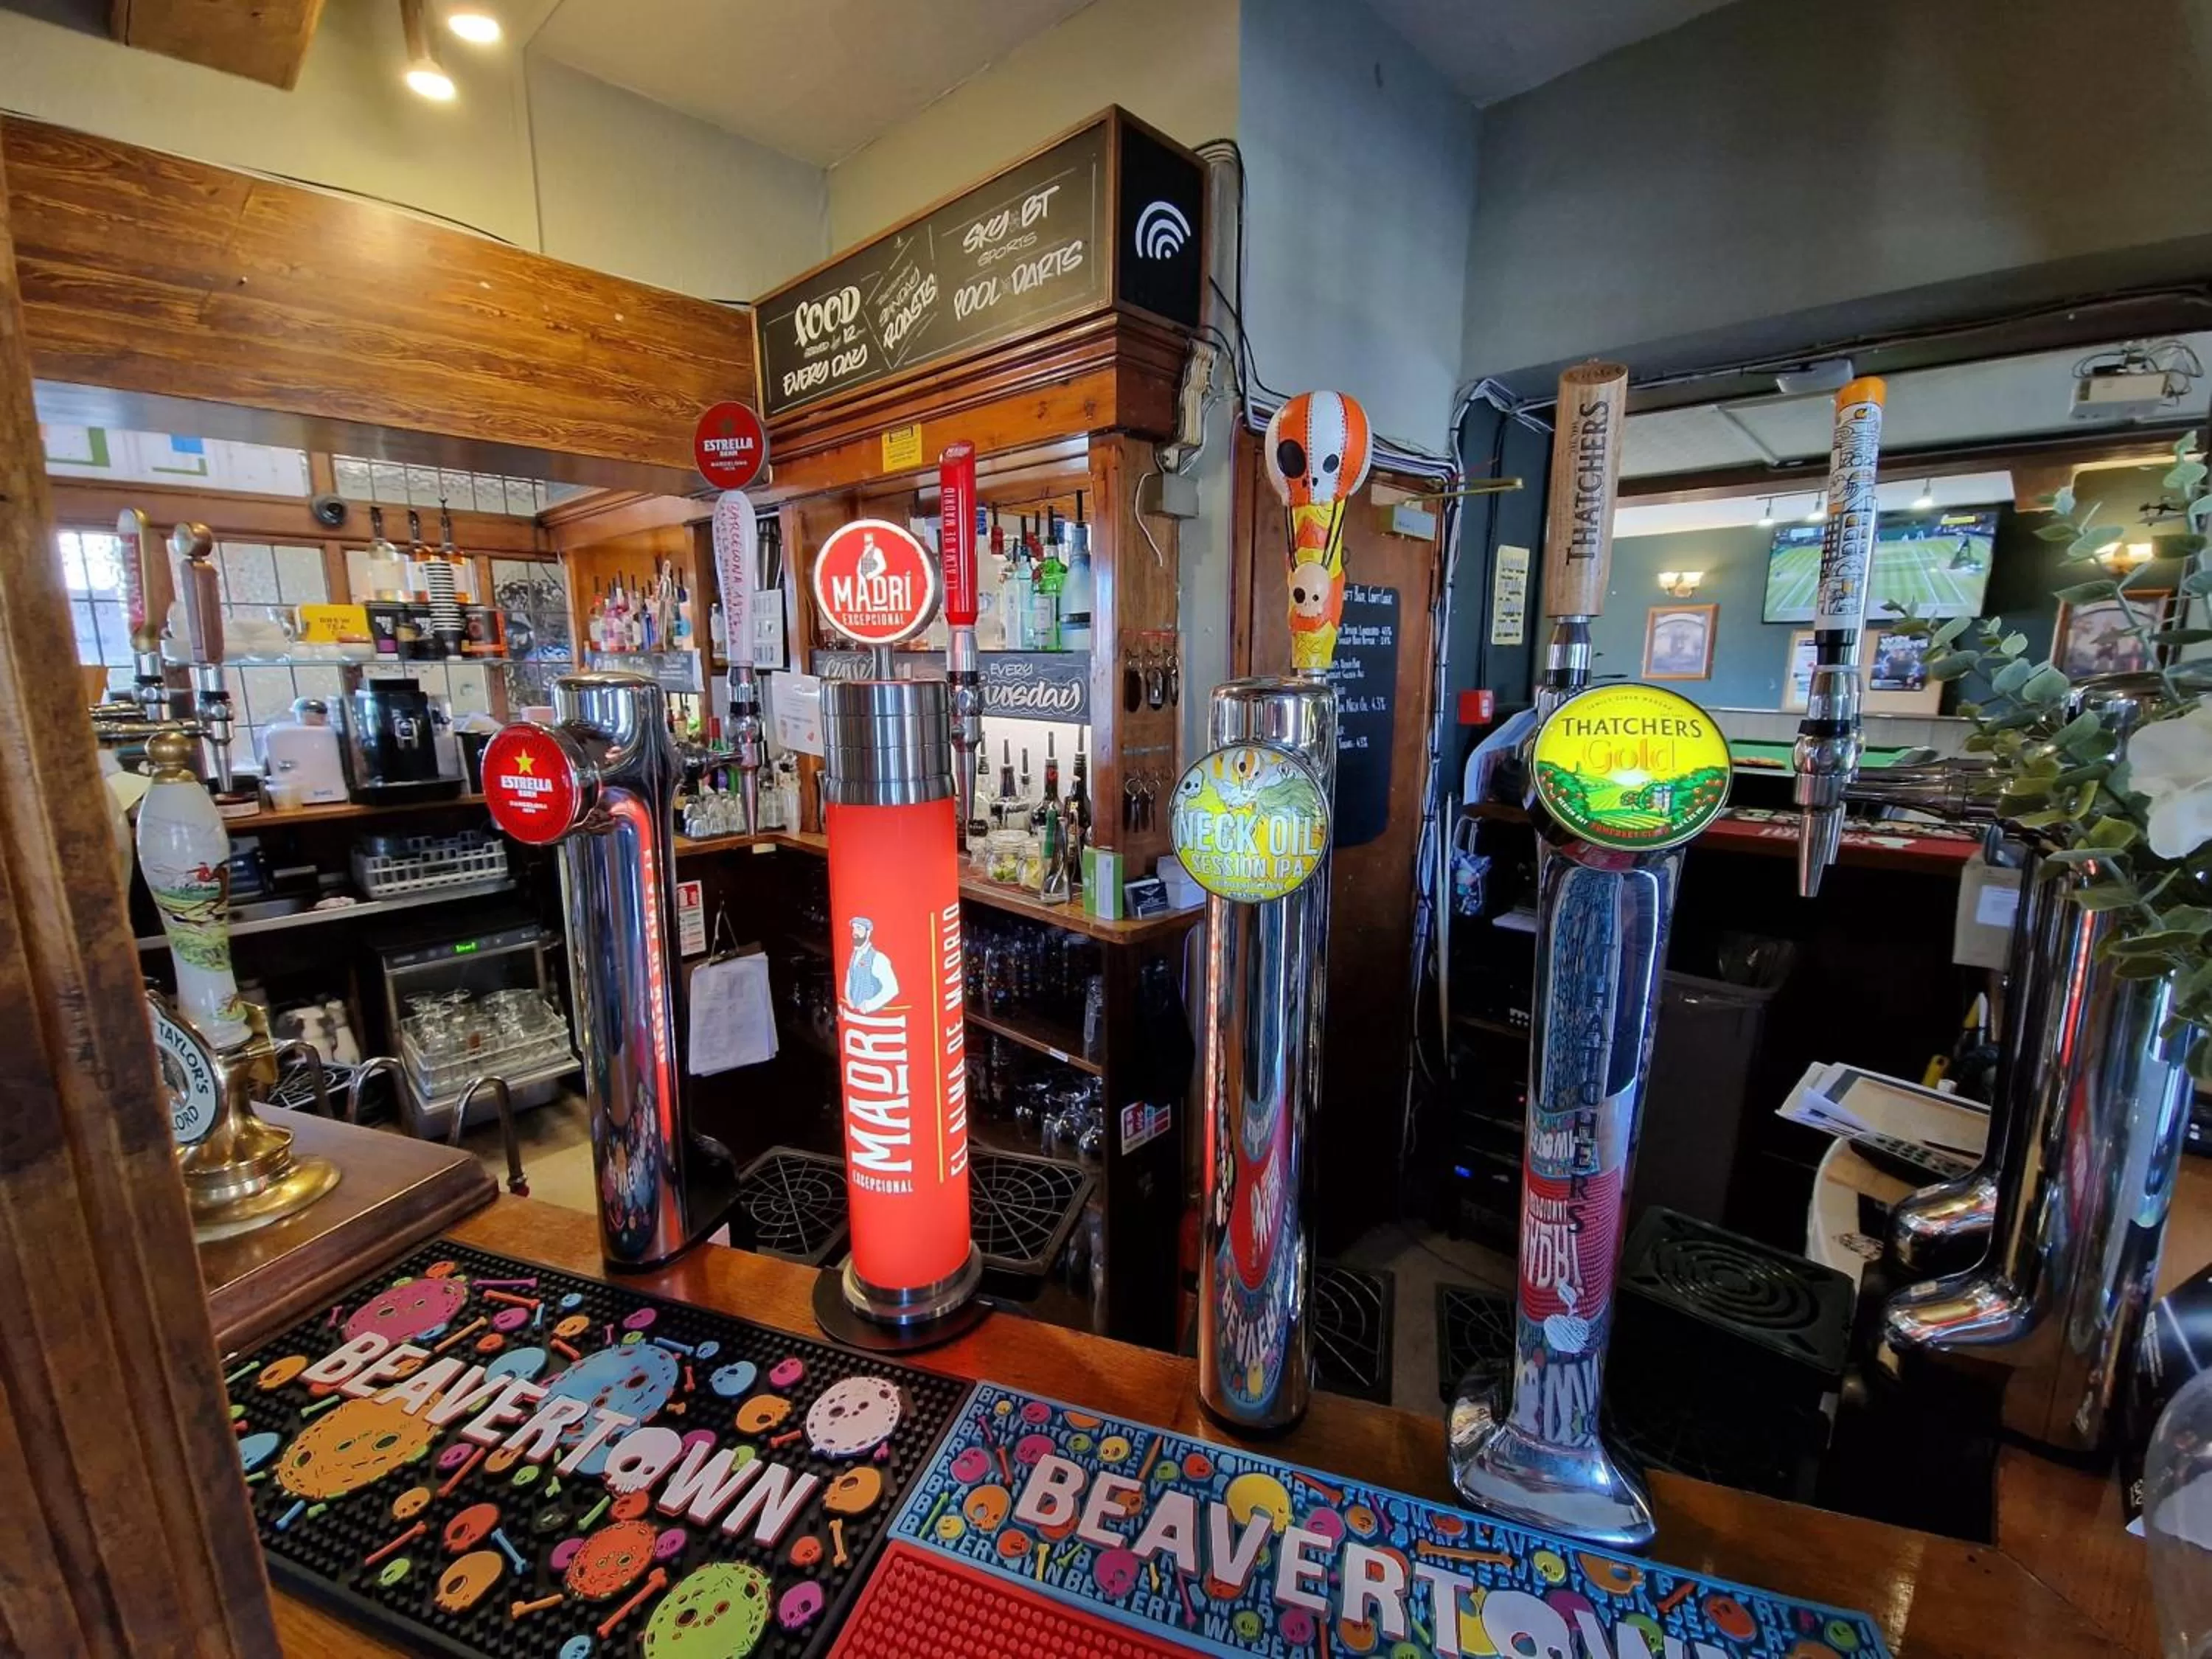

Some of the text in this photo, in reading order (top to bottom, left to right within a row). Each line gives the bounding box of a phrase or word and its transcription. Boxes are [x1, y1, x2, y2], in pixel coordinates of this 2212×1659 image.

[963, 185, 1060, 254] SKY BT
[978, 232, 1037, 266] SPORTS
[954, 277, 1001, 321] POOL
[1012, 240, 1083, 294] DARTS
[794, 286, 860, 347] FOOD
[883, 273, 938, 349] ROASTS
[783, 344, 867, 396] EVERY DAY
[703, 437, 754, 452] ESTRELLA
[1565, 401, 1610, 566] THATCHERS
[944, 487, 956, 526] MADRID
[843, 613, 905, 626] EXCEPCIONAL
[991, 663, 1033, 679] EVERY
[1561, 717, 1703, 738] THATCHERS
[1582, 739, 1676, 775] Gold
[501, 775, 554, 793] ESTRELLA
[1178, 810, 1318, 857] NECK OIL
[1191, 854, 1304, 878] SESSION IPA
[157, 1021, 209, 1095] TAYLOR'S
[943, 902, 968, 1177] EL ALMA DE MADRID
[171, 1105, 199, 1131] ORD
[852, 1170, 914, 1193] EXCEPCIONAL
[298, 1330, 818, 1549] BEAVERTOWN
